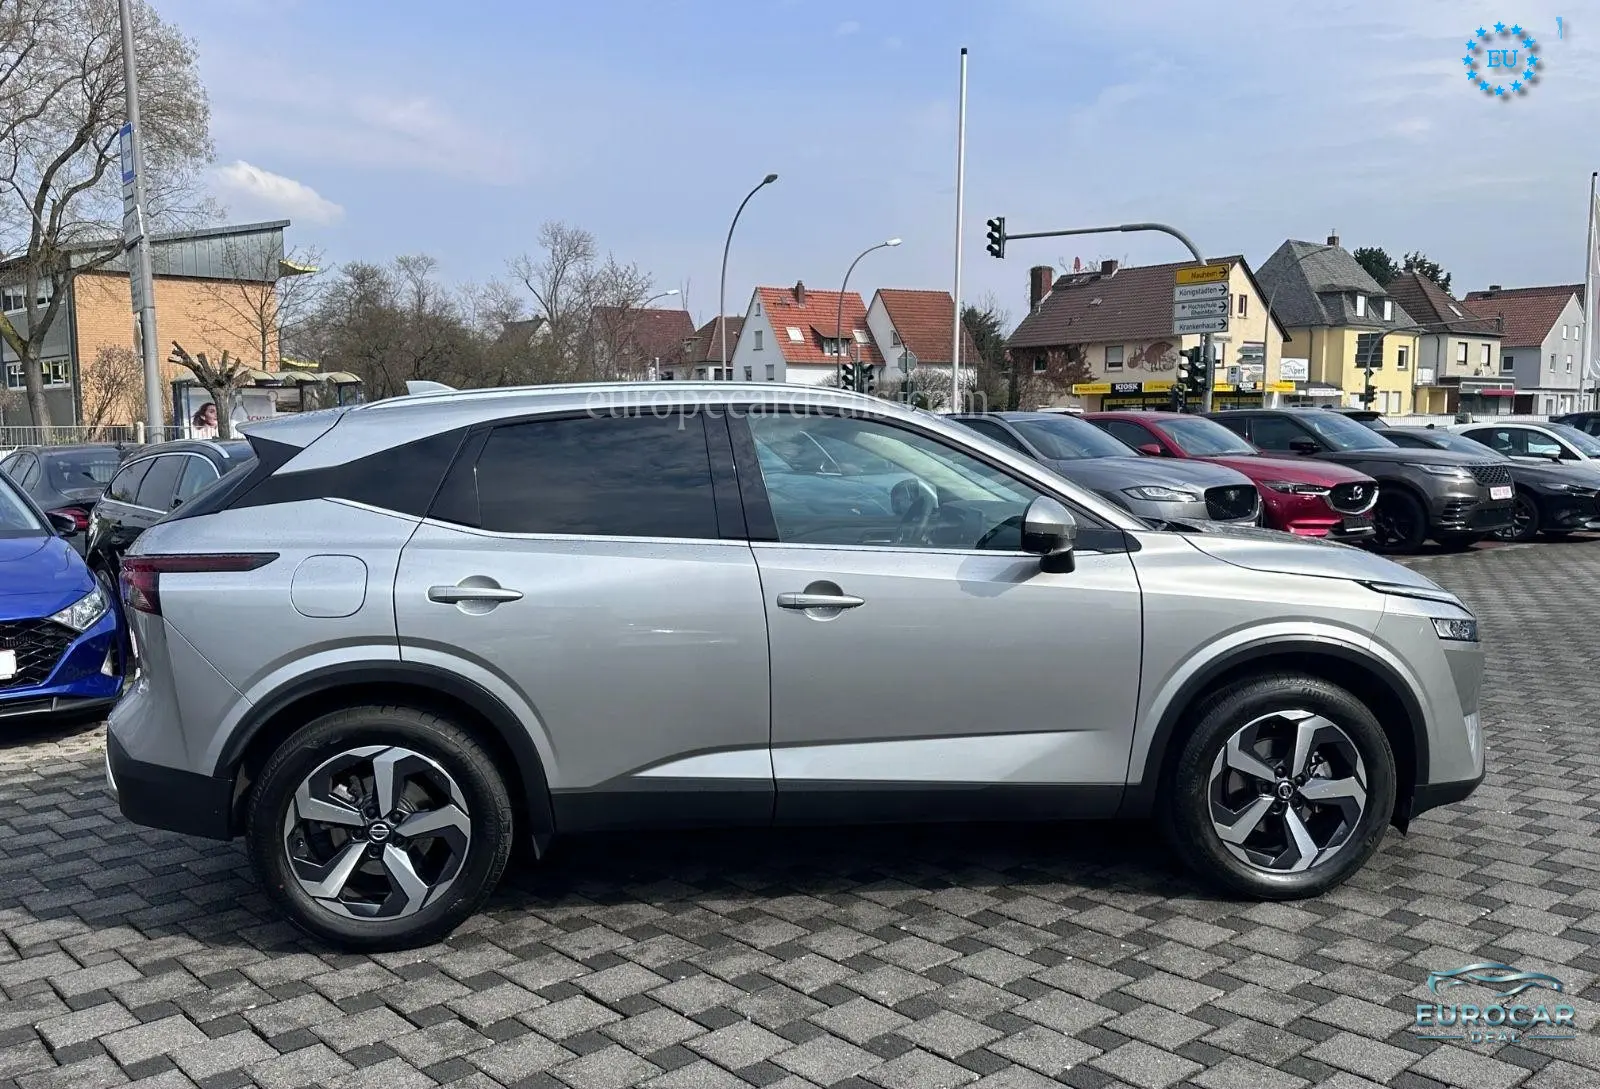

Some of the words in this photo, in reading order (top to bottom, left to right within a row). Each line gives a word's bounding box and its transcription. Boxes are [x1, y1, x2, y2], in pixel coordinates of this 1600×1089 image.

[1190, 270, 1218, 279] Nauheim
[1179, 322, 1217, 331] Krankenhaus
[1115, 383, 1139, 391] KIOSK
